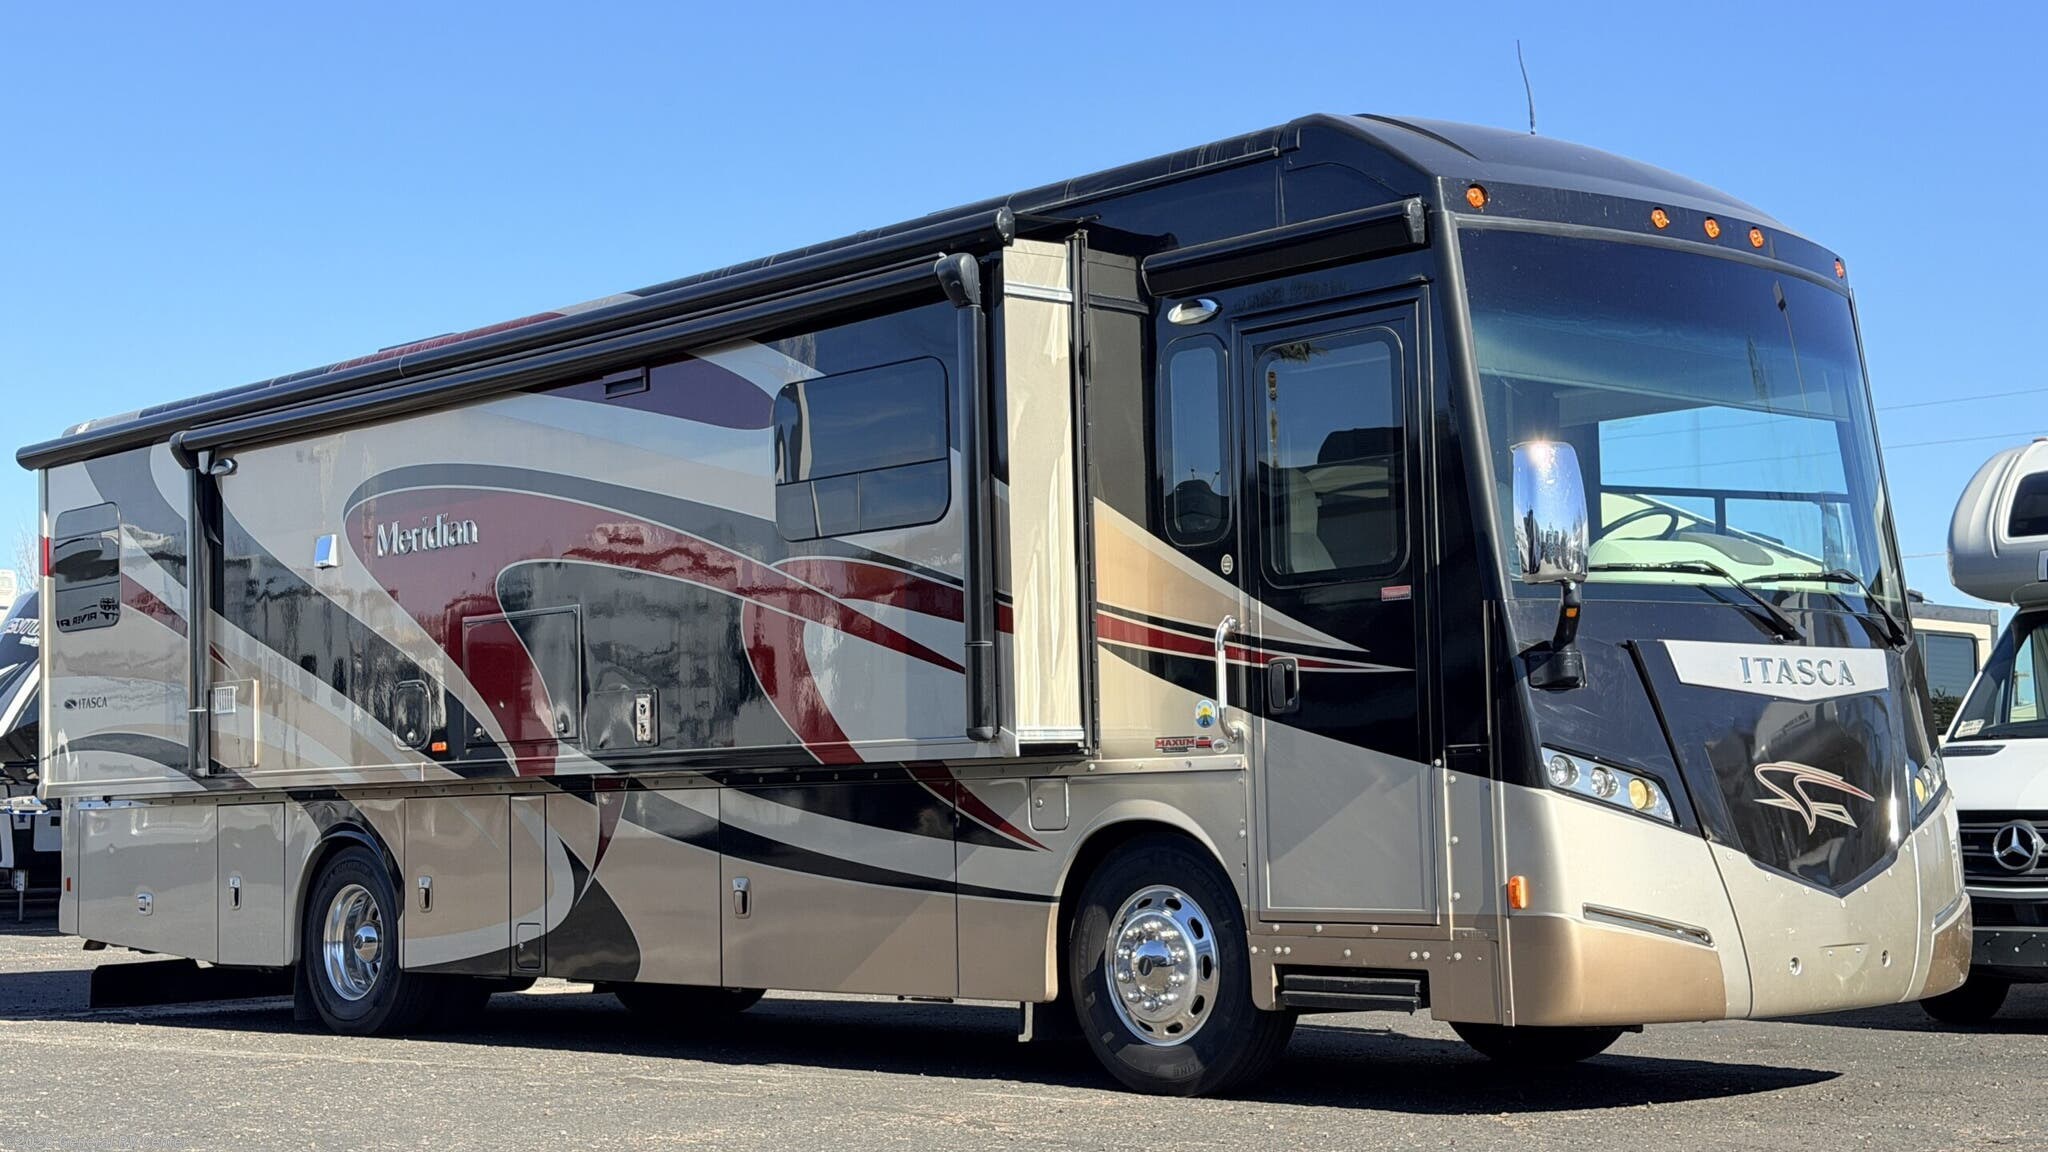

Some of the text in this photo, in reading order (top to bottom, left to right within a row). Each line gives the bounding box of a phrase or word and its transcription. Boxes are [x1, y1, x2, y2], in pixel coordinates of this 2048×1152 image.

[377, 513, 478, 556] Meridian
[1740, 656, 1856, 686] ITASCA
[78, 696, 108, 710] ITASCA
[1155, 738, 1195, 748] MAXUM
